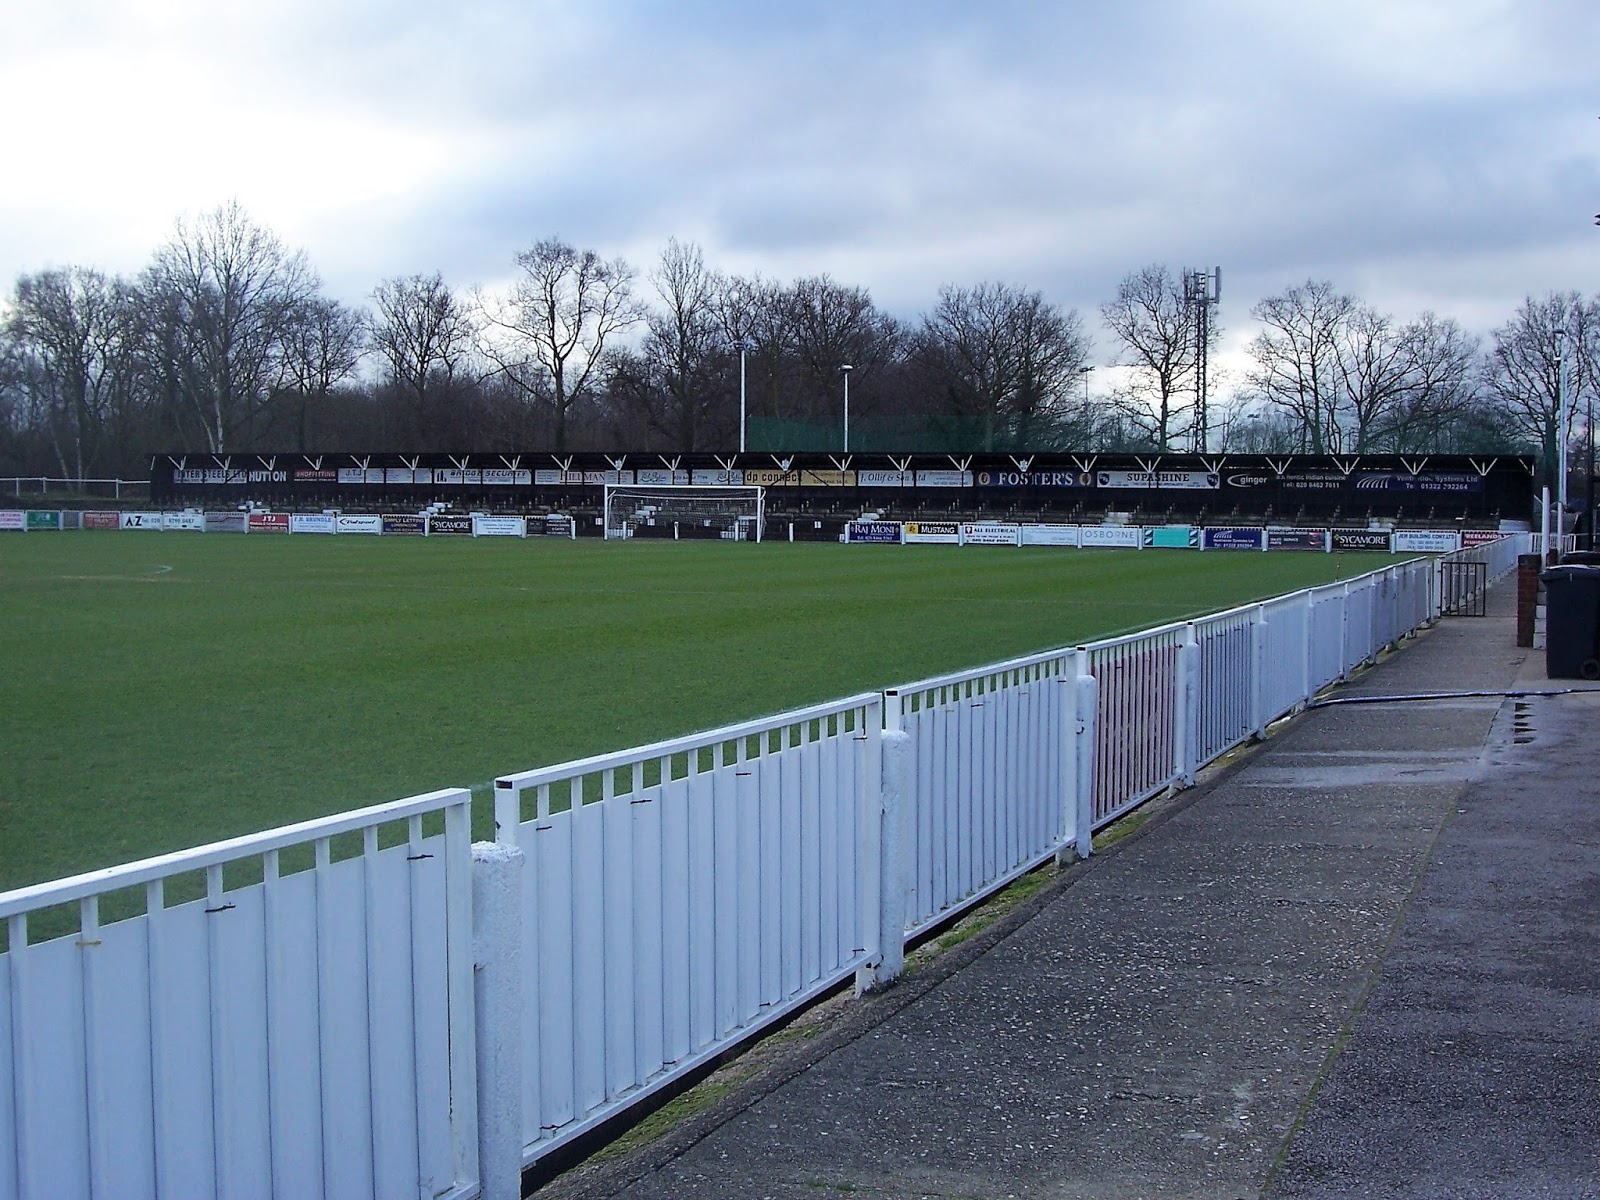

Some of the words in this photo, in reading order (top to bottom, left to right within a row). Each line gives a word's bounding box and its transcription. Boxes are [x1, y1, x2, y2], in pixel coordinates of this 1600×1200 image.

[248, 471, 287, 482] HUTTON
[746, 471, 758, 483] dp
[762, 473, 799, 482] connec
[887, 474, 894, 482] &
[896, 473, 910, 482] Sn
[998, 472, 1073, 486] FOSTER'S
[1126, 472, 1190, 482] SUPASHINE
[1240, 476, 1268, 485] ginger
[434, 521, 470, 529] SYCAMORE
[855, 524, 869, 534] RAJ
[870, 524, 895, 533] MONI
[921, 525, 955, 534] MUSTANG
[1084, 530, 1135, 539] OSBORNE
[1339, 535, 1387, 544] SYCAMORE
